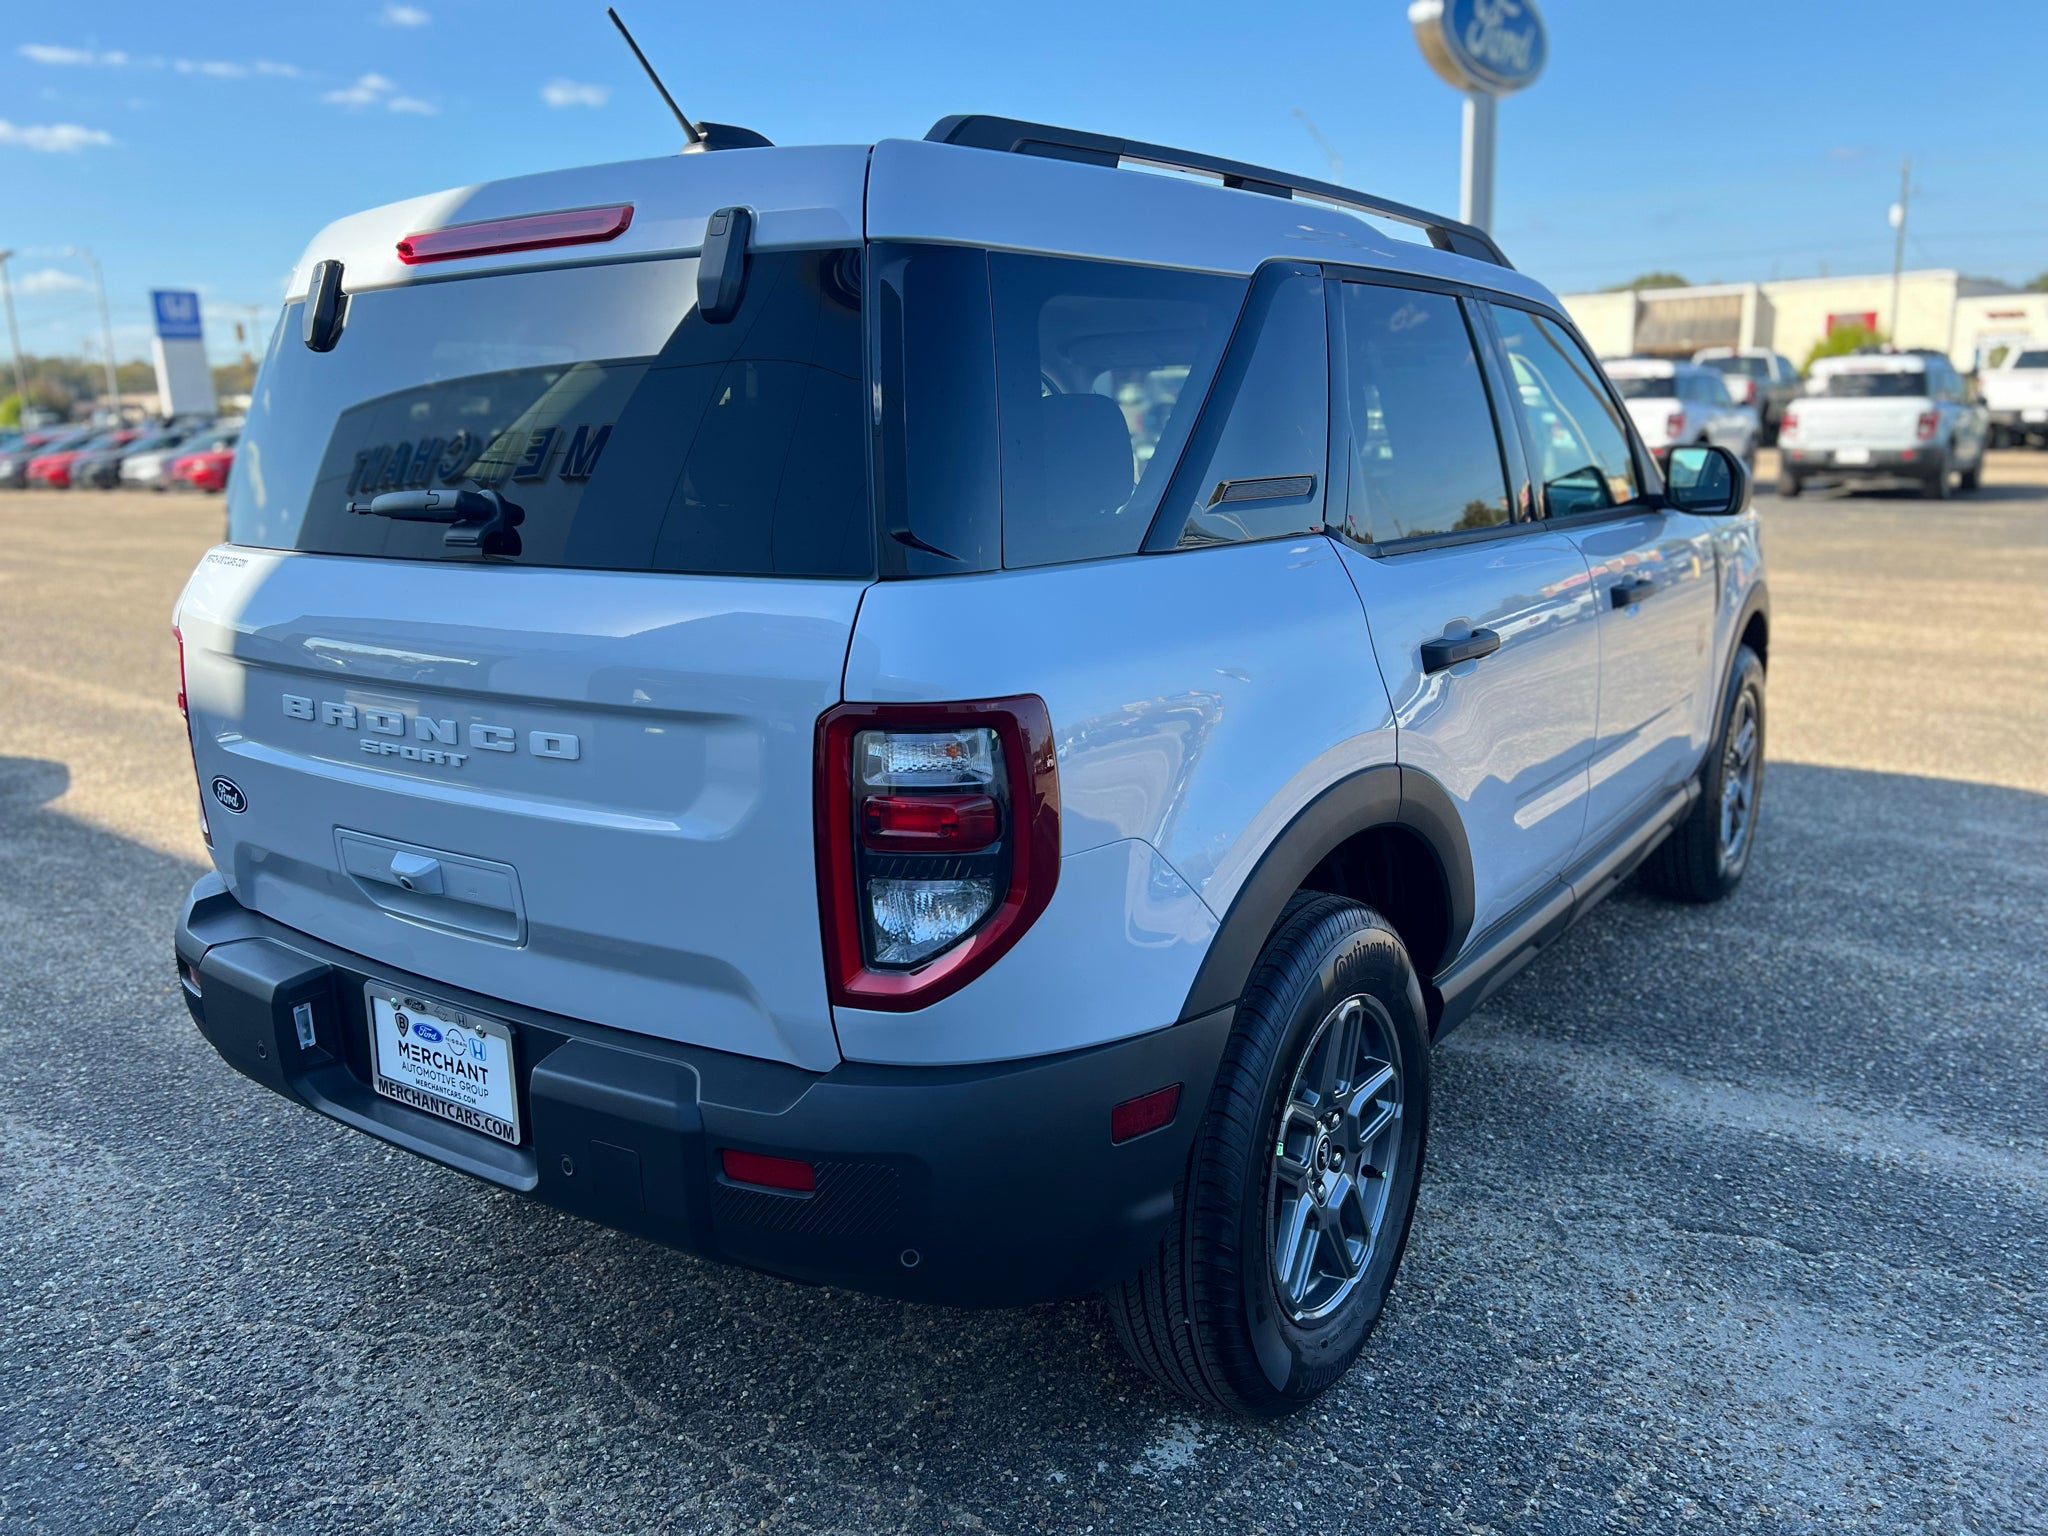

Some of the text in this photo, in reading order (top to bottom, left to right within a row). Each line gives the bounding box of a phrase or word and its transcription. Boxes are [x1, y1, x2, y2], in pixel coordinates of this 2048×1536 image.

[282, 693, 581, 761] BRONCO
[359, 738, 469, 768] SPORT
[217, 781, 240, 809] Ford
[1333, 939, 1396, 986] Continental
[418, 1025, 438, 1041] Ford
[398, 1040, 489, 1085] MERCHANT
[402, 1061, 489, 1099] AUTOMOTIVE GROUP
[378, 1078, 515, 1142] MERCHANTCARS.COM
[415, 1078, 477, 1105] MERCHANTCARS.COM
